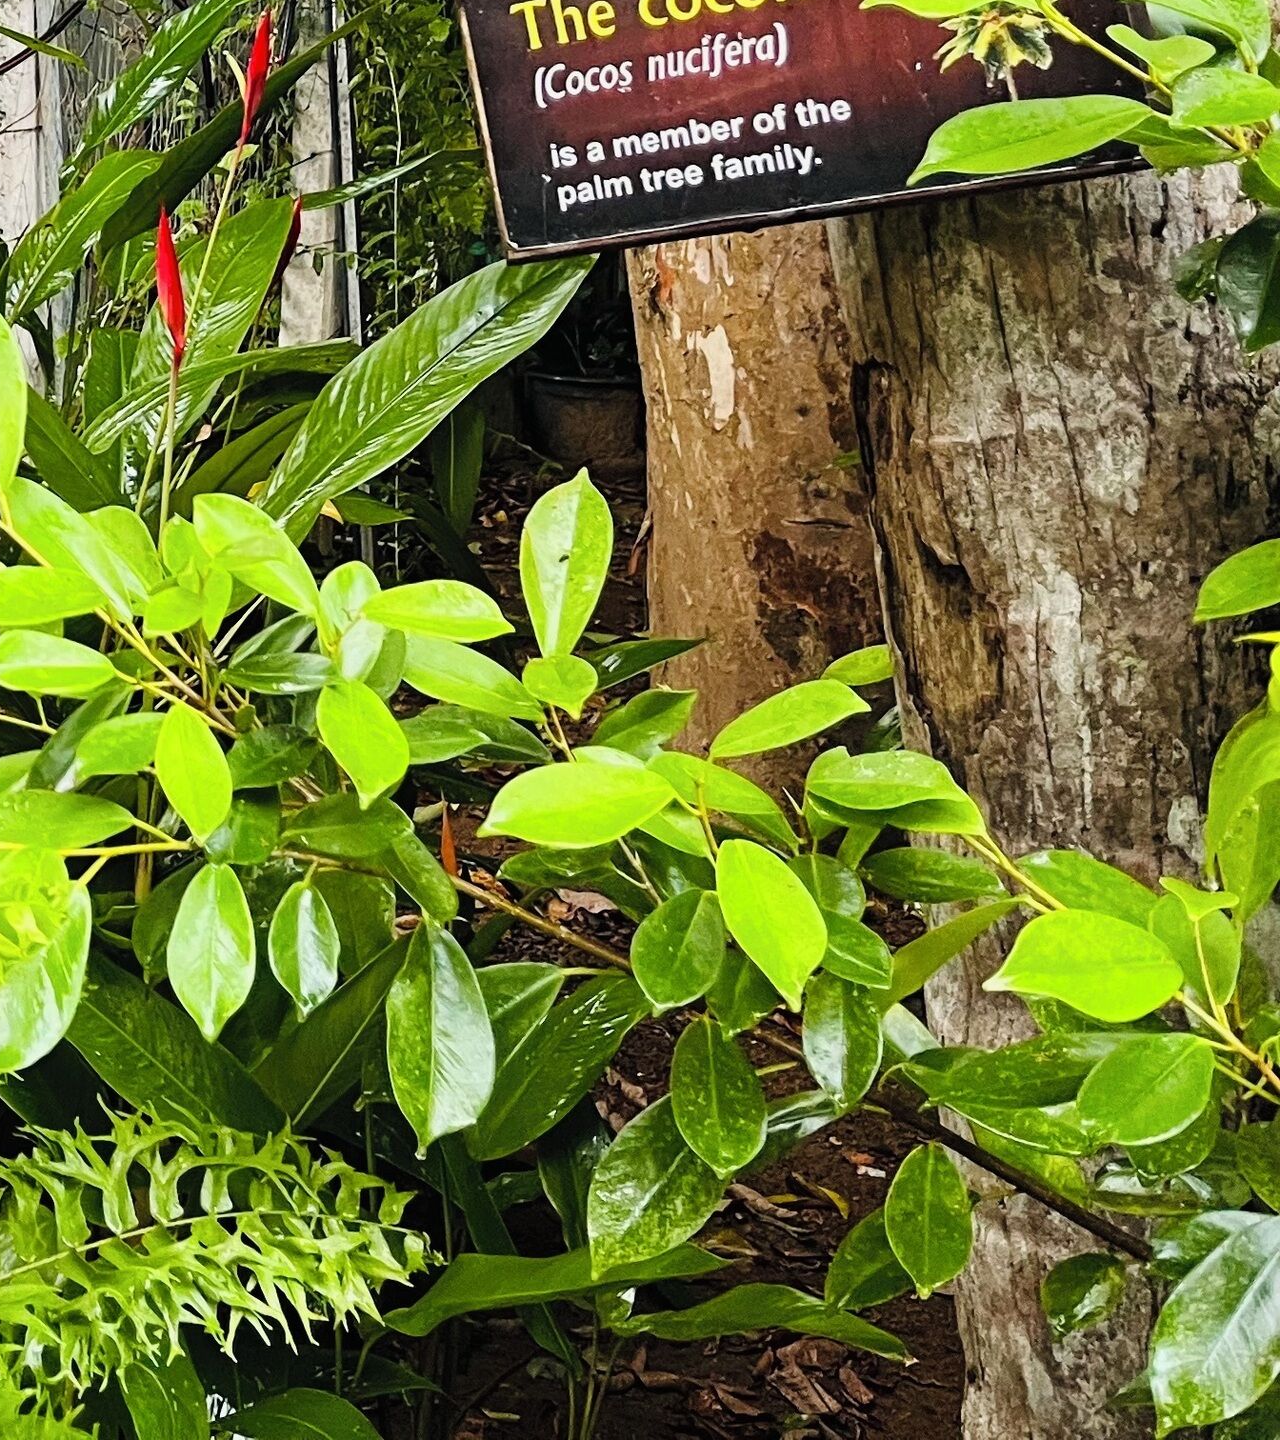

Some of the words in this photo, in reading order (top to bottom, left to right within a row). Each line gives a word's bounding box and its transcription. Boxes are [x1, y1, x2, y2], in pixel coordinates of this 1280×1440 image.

[534, 60, 633, 109] (Cocos
[647, 21, 788, 83] nucifera)
[550, 143, 578, 168] is
[586, 140, 605, 163] a
[612, 115, 744, 158] member
[752, 103, 787, 135] of
[794, 98, 852, 129] the
[557, 173, 634, 212] palm
[640, 164, 705, 194] tree
[710, 143, 824, 182] family.
